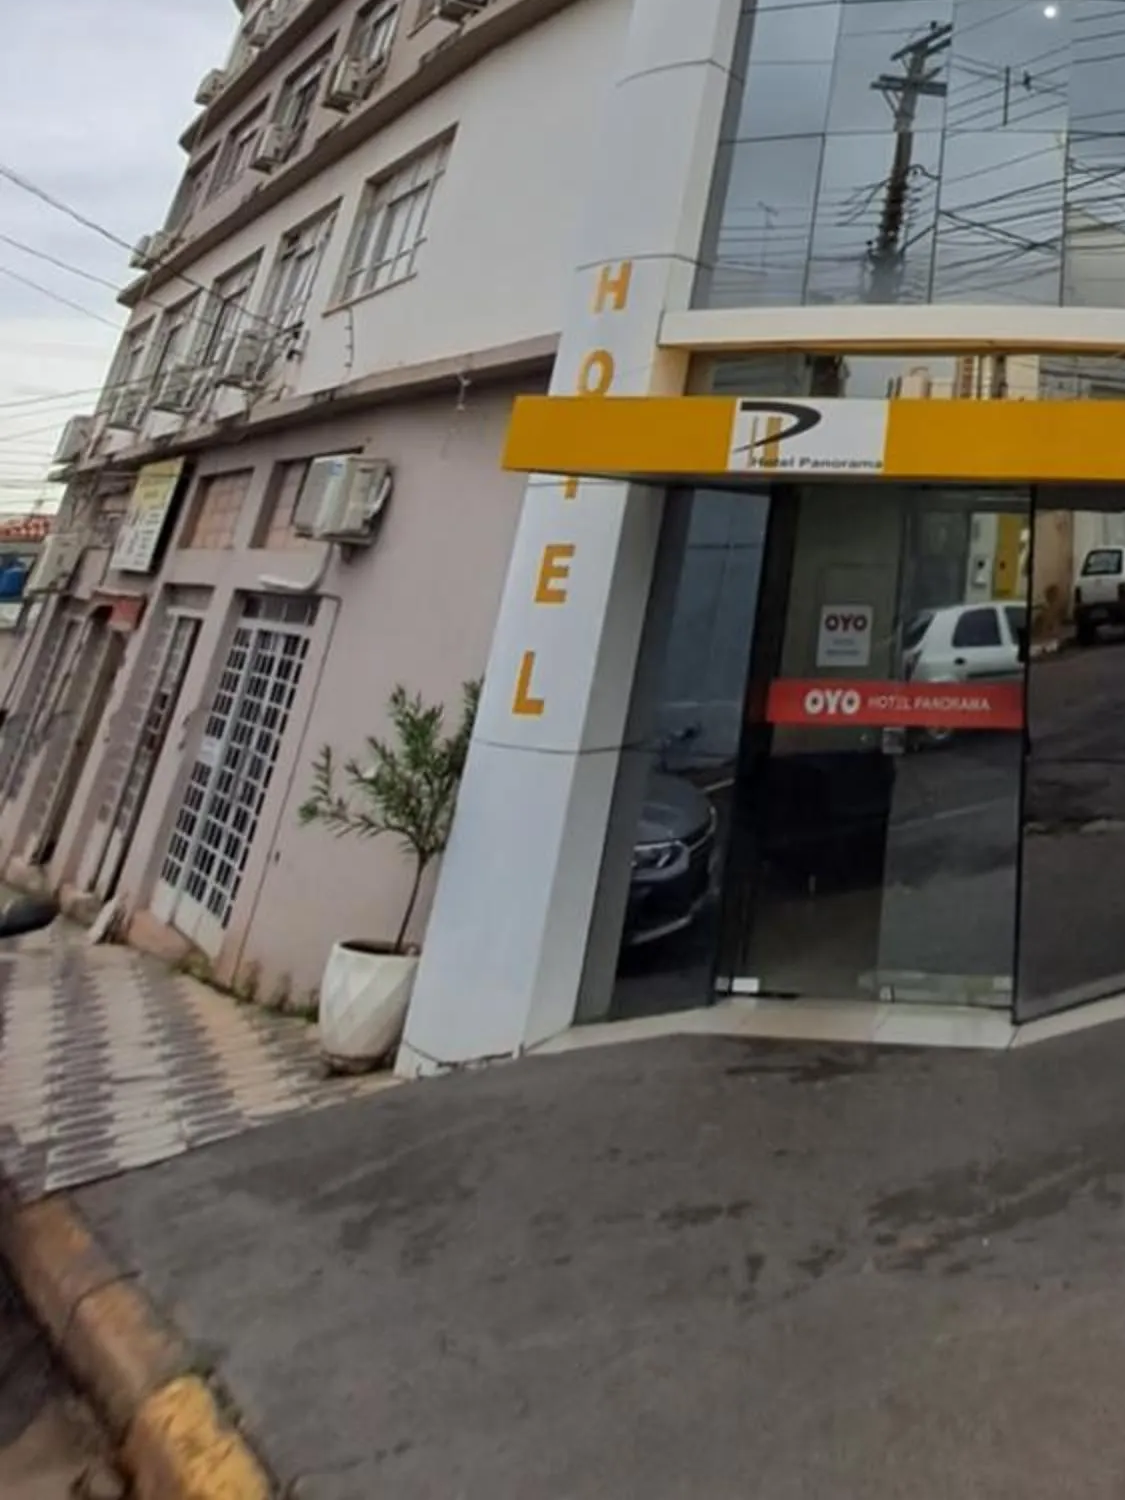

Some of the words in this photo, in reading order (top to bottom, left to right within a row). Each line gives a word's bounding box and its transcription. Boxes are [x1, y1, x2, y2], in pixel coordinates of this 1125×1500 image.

[799, 456, 884, 469] Panorama
[825, 613, 868, 632] OYO
[804, 688, 861, 715] OYO
[867, 695, 911, 710] HOTEL
[913, 696, 991, 711] PANORAMA
